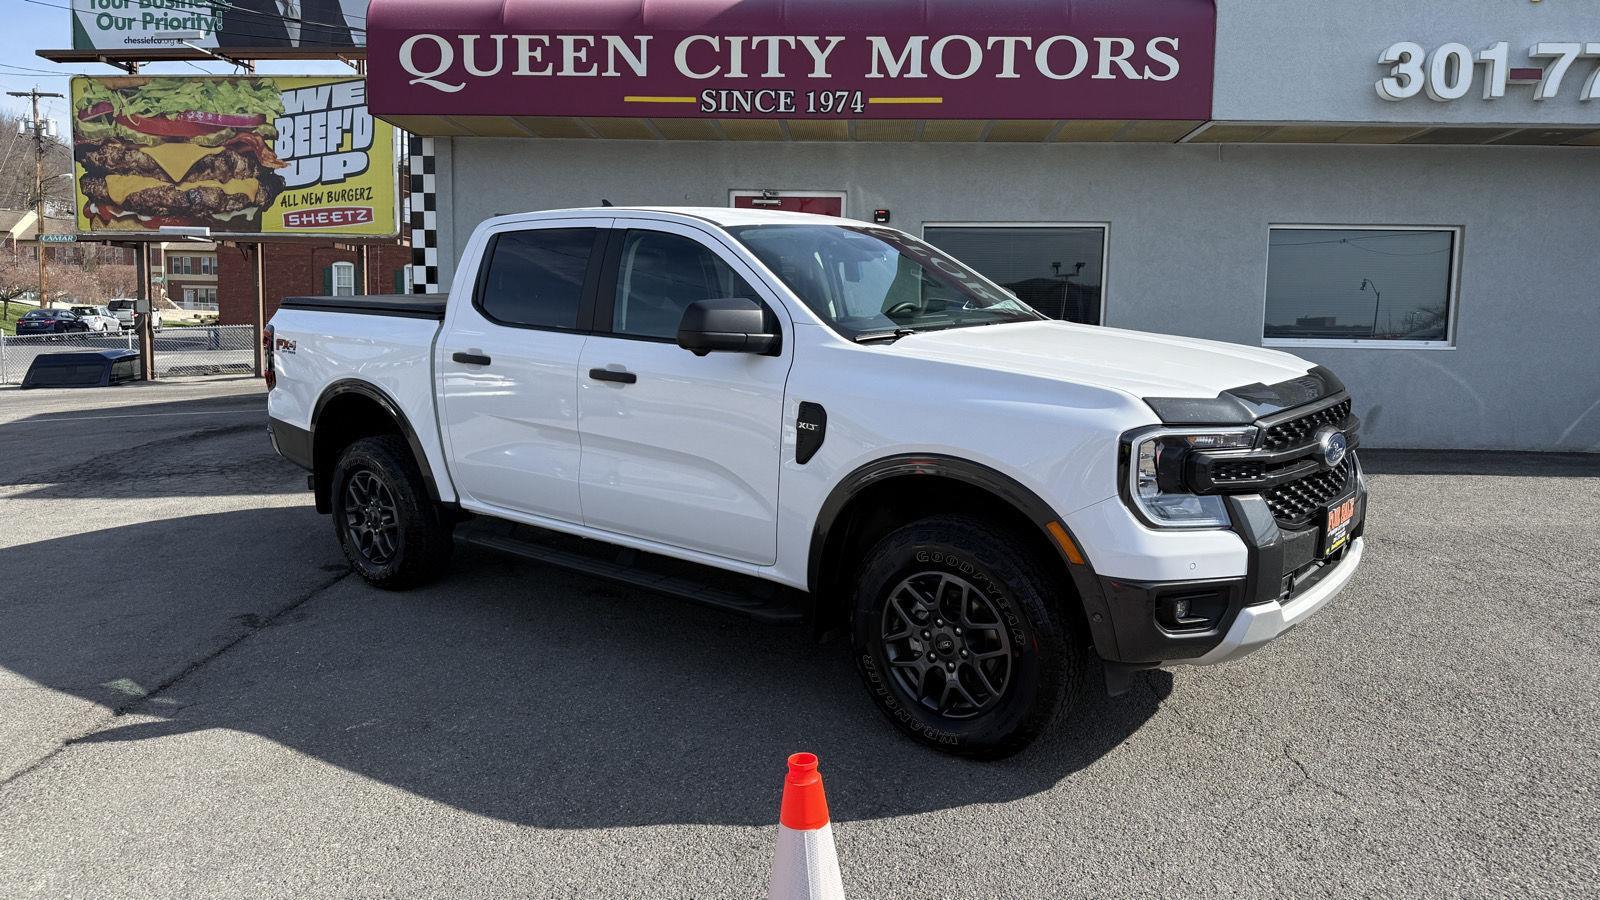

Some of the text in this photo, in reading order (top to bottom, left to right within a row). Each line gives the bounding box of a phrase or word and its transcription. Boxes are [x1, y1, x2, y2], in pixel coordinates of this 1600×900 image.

[96, 11, 223, 36] Our Priority!
[399, 33, 1181, 92] QUEEN CITY MOTORS
[281, 79, 366, 115] WE
[700, 89, 866, 114] SINCE 1974
[274, 105, 374, 160] BEEF'D
[274, 151, 369, 188] UP
[280, 186, 374, 208] ALL NEW BURGERZ
[288, 209, 368, 226] SHEETZ
[41, 234, 74, 242] LAMAR
[798, 421, 819, 431] XLT
[915, 550, 1027, 647] GOODYEAR
